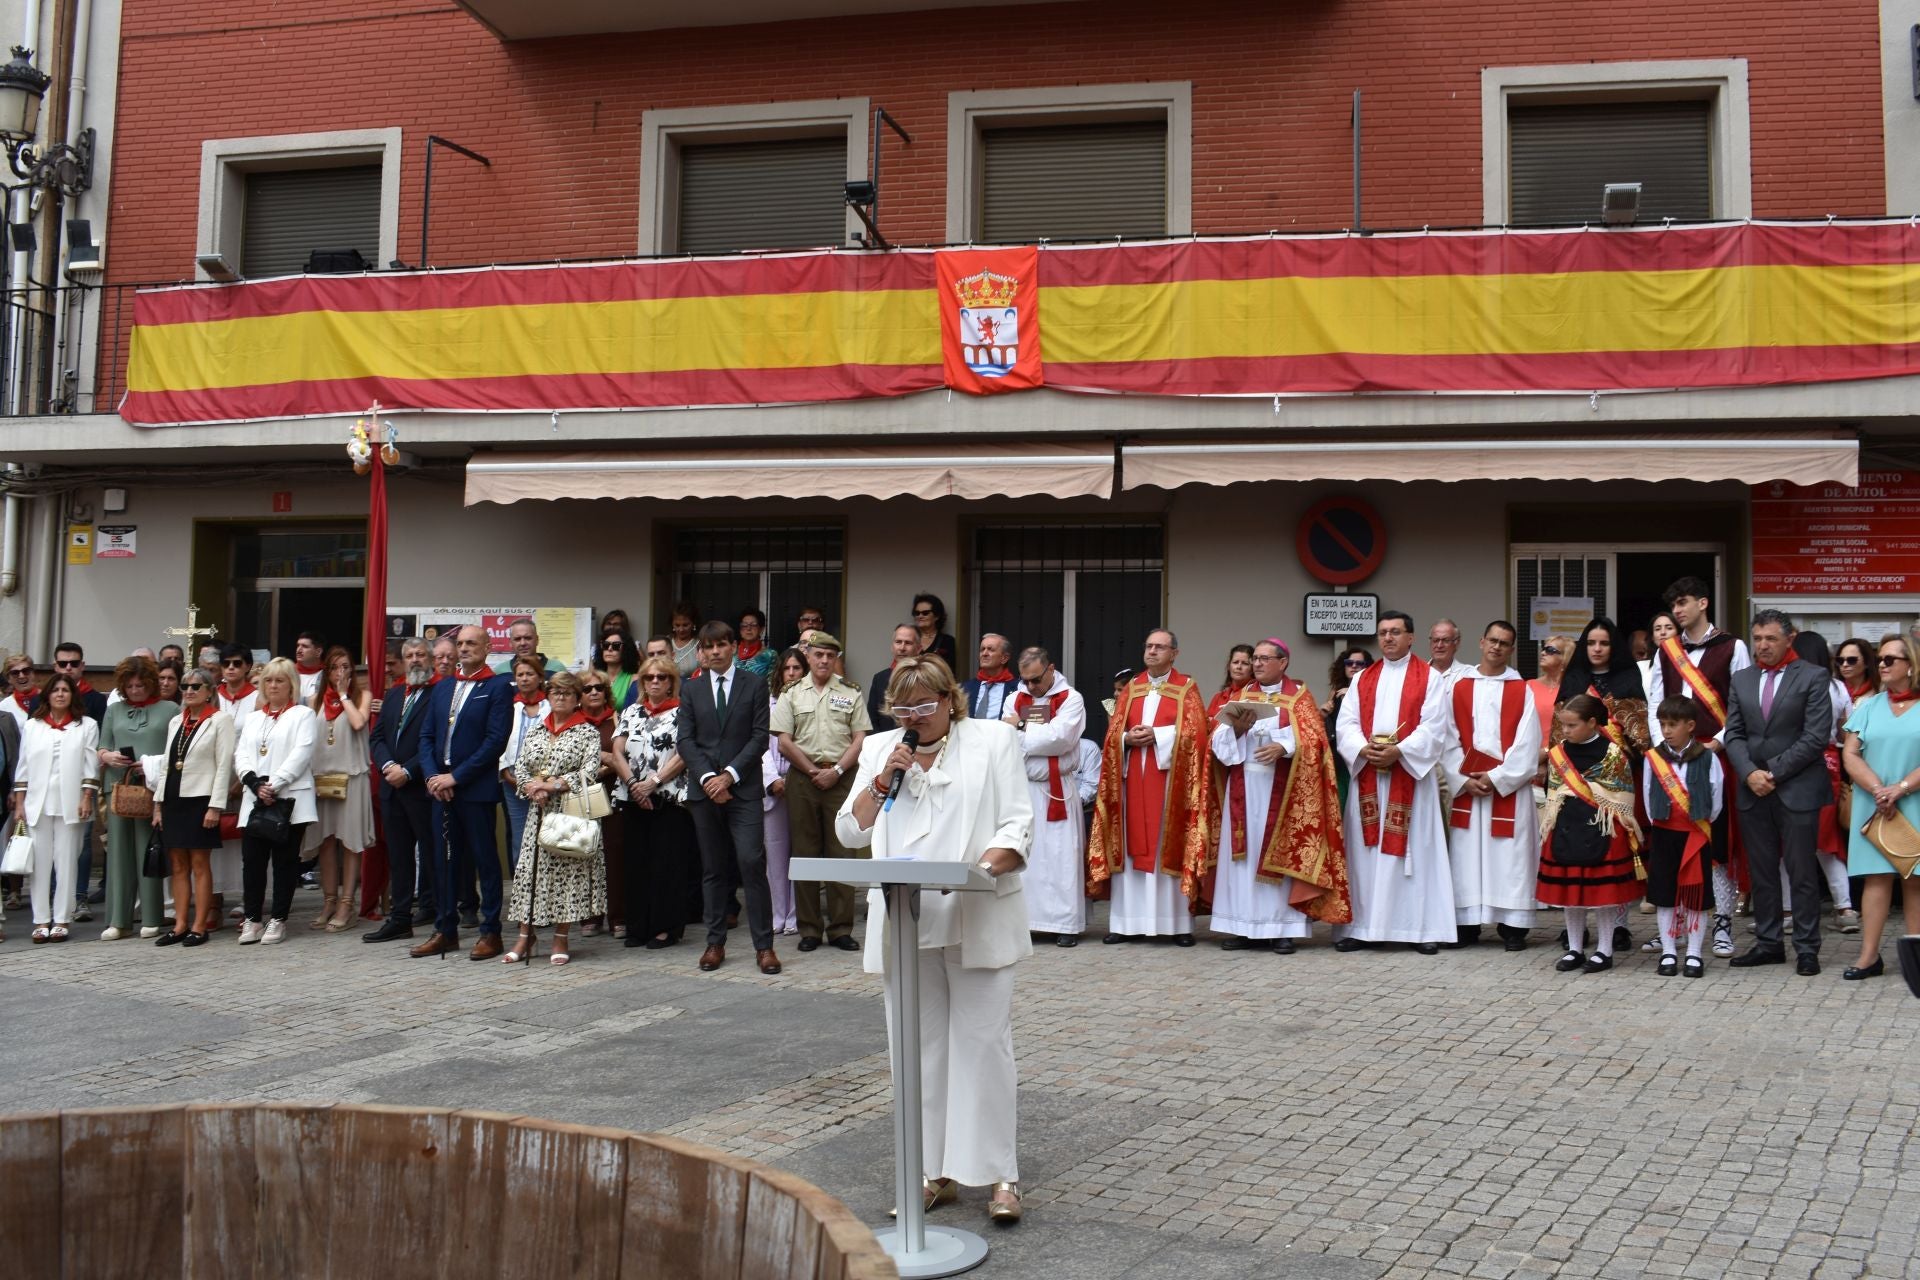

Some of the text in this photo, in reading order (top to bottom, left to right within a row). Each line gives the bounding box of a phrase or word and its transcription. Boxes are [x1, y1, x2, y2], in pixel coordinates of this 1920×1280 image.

[1824, 488, 1841, 497] DE
[1845, 487, 1887, 497] AUTOL
[1833, 505, 1875, 513] MUNICIPALES
[1814, 575, 1848, 583] ATENCIÓN
[1860, 575, 1906, 583] CONSUMIDOR
[1311, 599, 1372, 608] EN TODA LA PLAZA
[1310, 611, 1373, 620] EXCEPTO VEHICULOS
[1321, 623, 1364, 631] AUTORIZADOS
